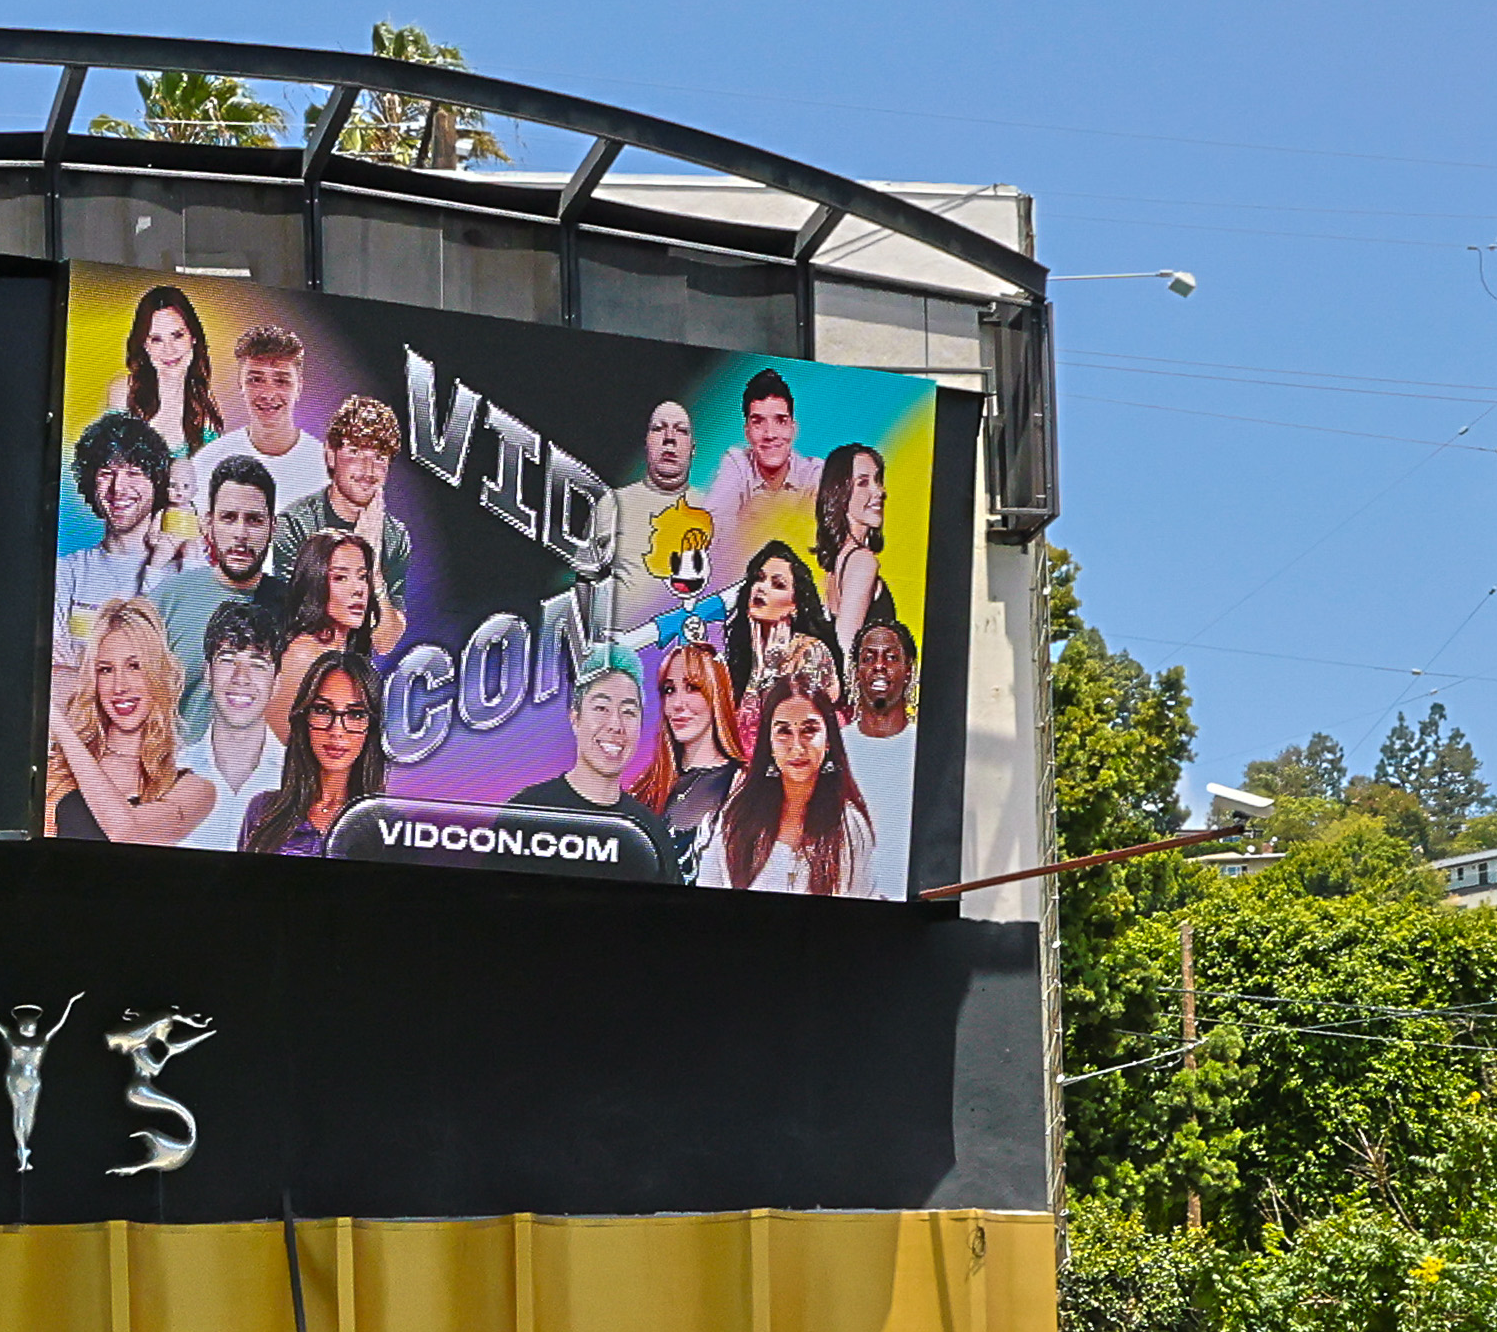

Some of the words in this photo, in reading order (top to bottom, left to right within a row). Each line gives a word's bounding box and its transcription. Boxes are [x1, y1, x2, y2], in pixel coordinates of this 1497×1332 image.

[403, 343, 619, 571] VID
[381, 575, 612, 763] CON
[378, 819, 620, 863] VIDCON.COM
